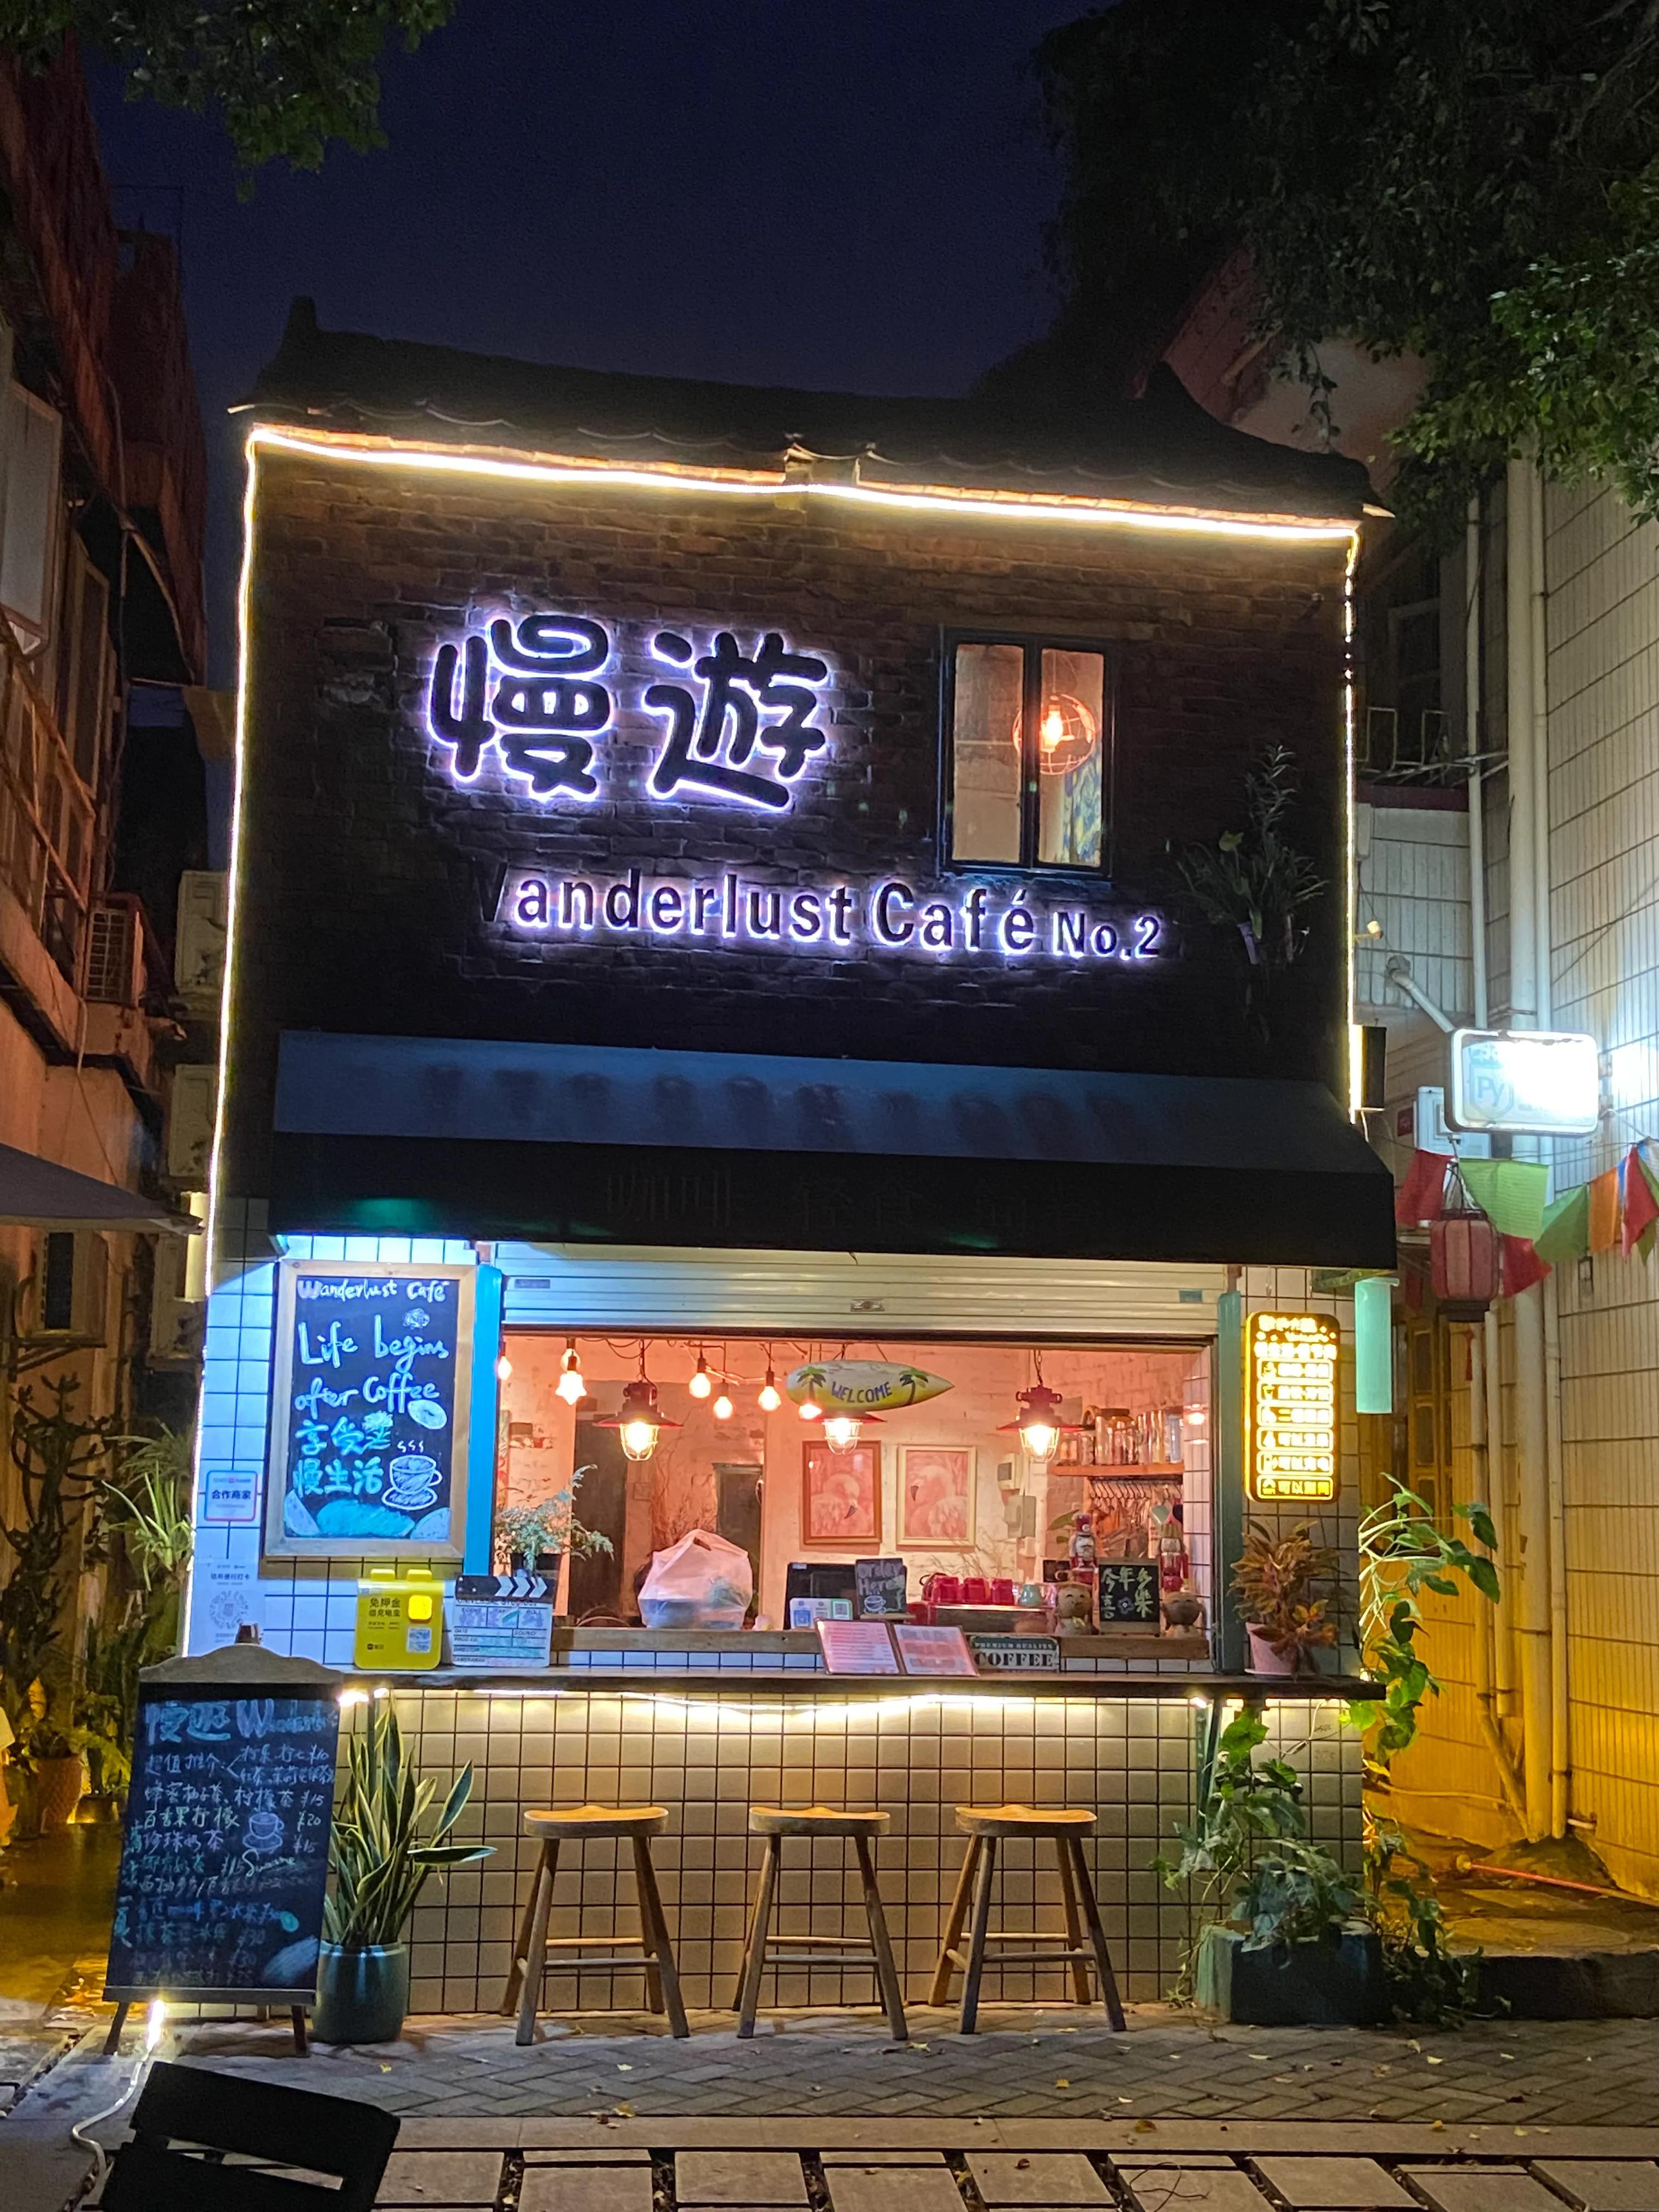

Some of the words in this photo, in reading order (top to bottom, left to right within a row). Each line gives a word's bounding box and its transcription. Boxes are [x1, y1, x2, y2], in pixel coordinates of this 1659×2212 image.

[876, 882, 1034, 952] Café
[1055, 911, 1160, 959] No.2
[297, 1278, 397, 1301] Wanderlust
[407, 1280, 449, 1303] Café
[298, 1321, 358, 1368] Life
[374, 1314, 449, 1373] begins
[363, 1371, 439, 1413] Coffee
[831, 1381, 893, 1403] WELCOME
[295, 1415, 365, 1455] 享受
[293, 1456, 384, 1498] 慢生活
[212, 1490, 251, 1499] 合作商家
[370, 1598, 400, 1608] 免押金
[974, 1651, 1053, 1667] COFFEE
